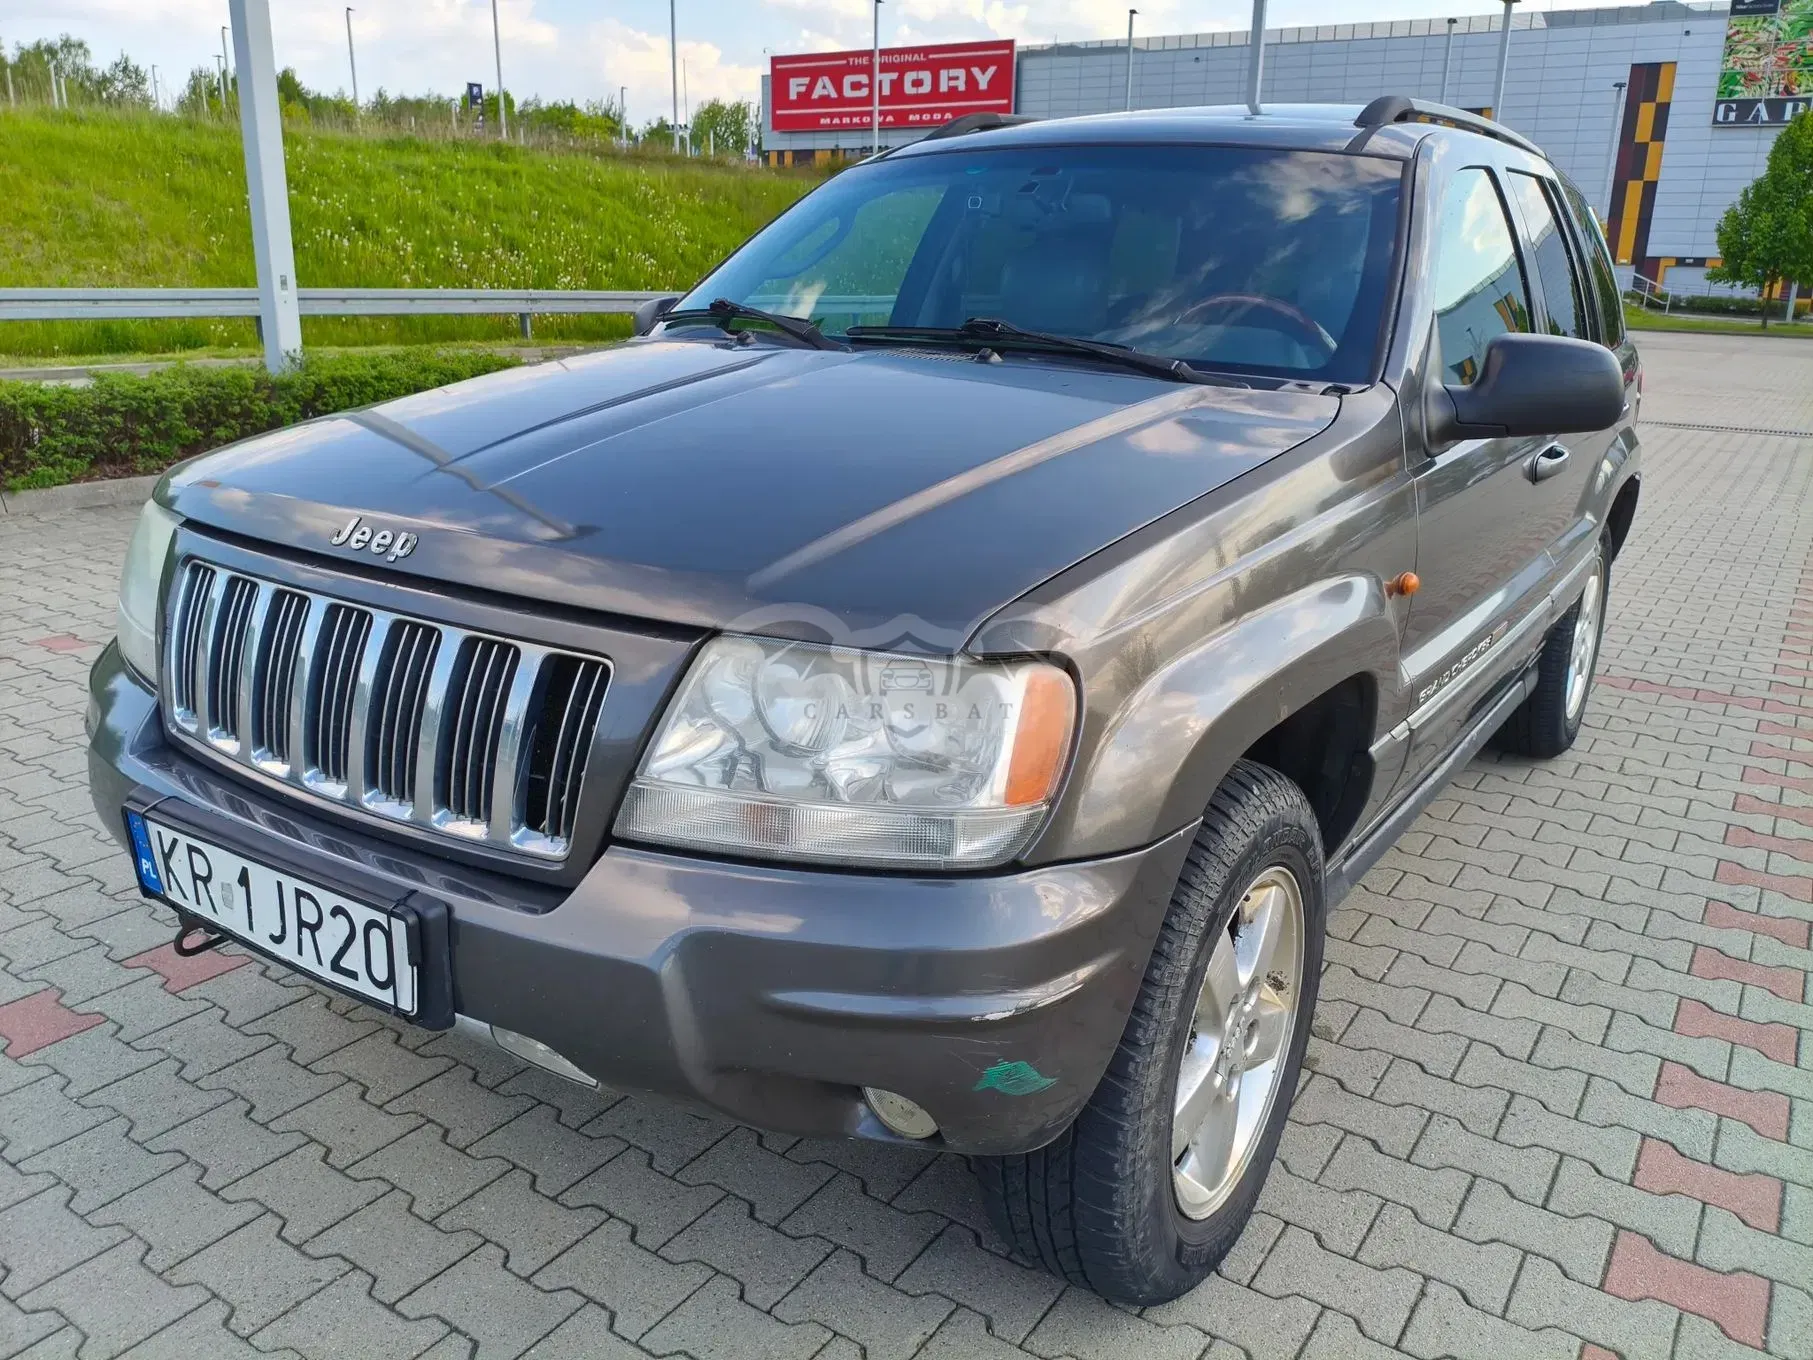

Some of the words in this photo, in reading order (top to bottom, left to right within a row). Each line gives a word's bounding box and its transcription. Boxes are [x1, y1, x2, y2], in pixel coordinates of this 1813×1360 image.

[848, 56, 870, 66] THE
[789, 65, 998, 100] FACTORY
[908, 112, 954, 121] MODA
[1716, 102, 1806, 122] GAP
[330, 516, 419, 563] Jeep
[141, 857, 158, 880] PL
[157, 830, 219, 915] KR
[237, 865, 395, 991] 1JR20
